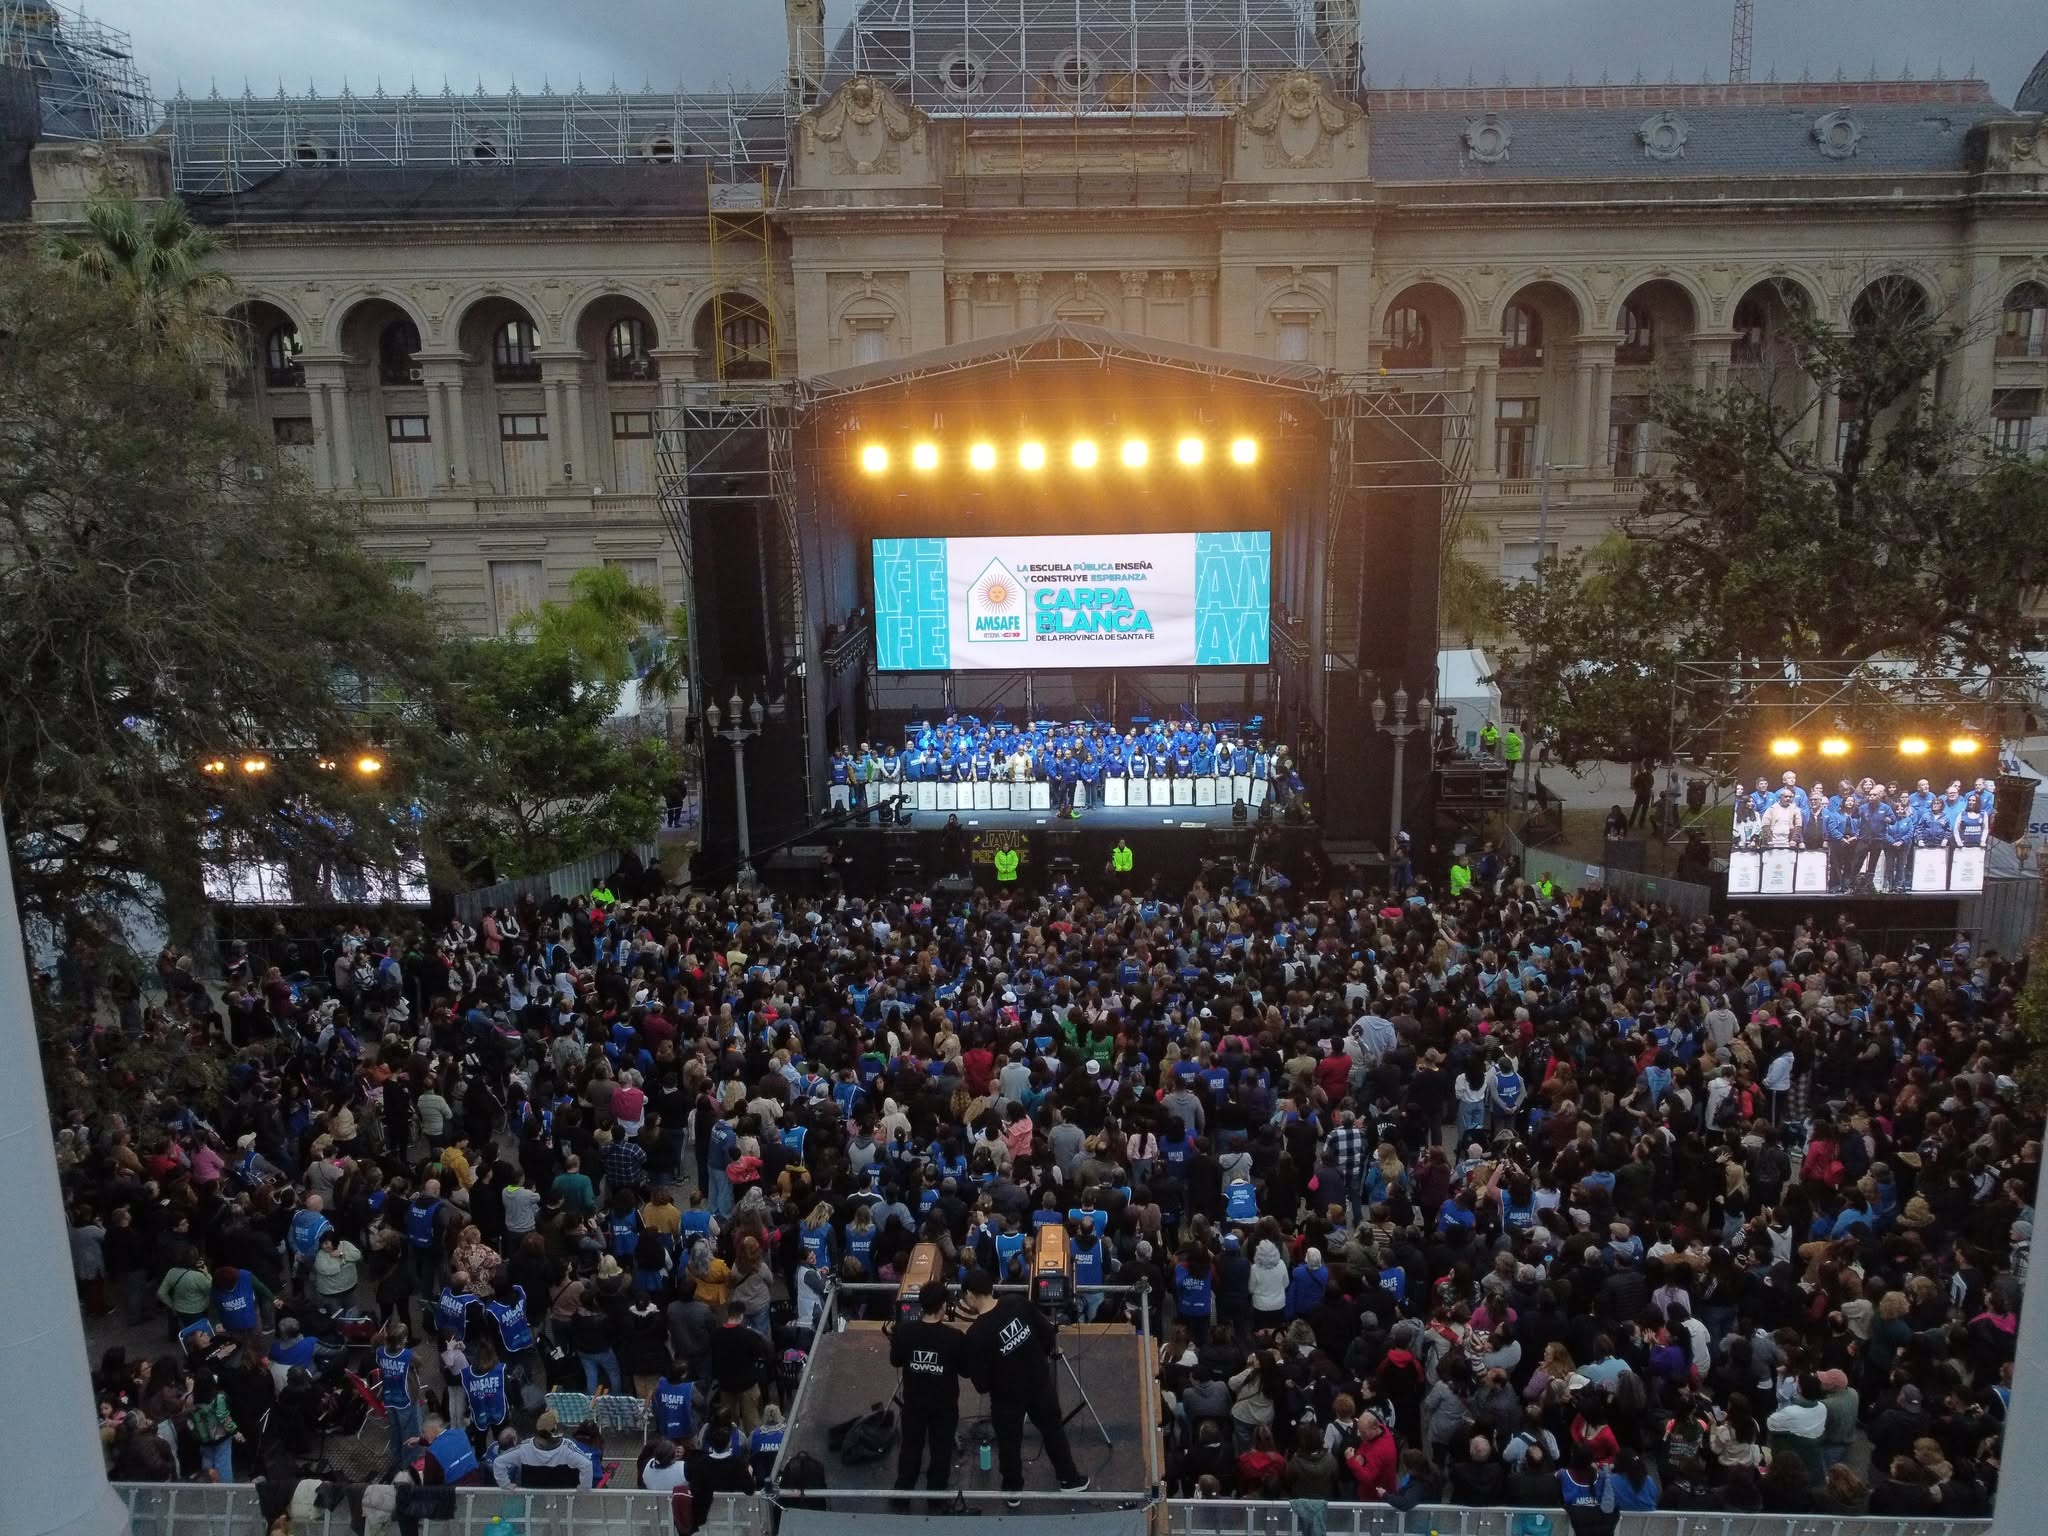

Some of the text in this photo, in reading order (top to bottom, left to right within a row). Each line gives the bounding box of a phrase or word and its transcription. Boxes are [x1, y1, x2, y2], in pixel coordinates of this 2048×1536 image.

[1017, 561, 1153, 572] LA ESCUELA PÚBLICA ENSEÑA
[1031, 574, 1088, 582] CONSTRUYE
[1091, 573, 1147, 581] ESPERANZA
[1034, 587, 1134, 610] CARPA
[976, 616, 1020, 630] AMSAFE
[1035, 610, 1153, 634] BLANCA
[982, 830, 1019, 848] JAVI
[1000, 1325, 1030, 1353] YOWON
[470, 1377, 499, 1392] AMSAFE
[661, 1393, 684, 1405] AMSAFE
